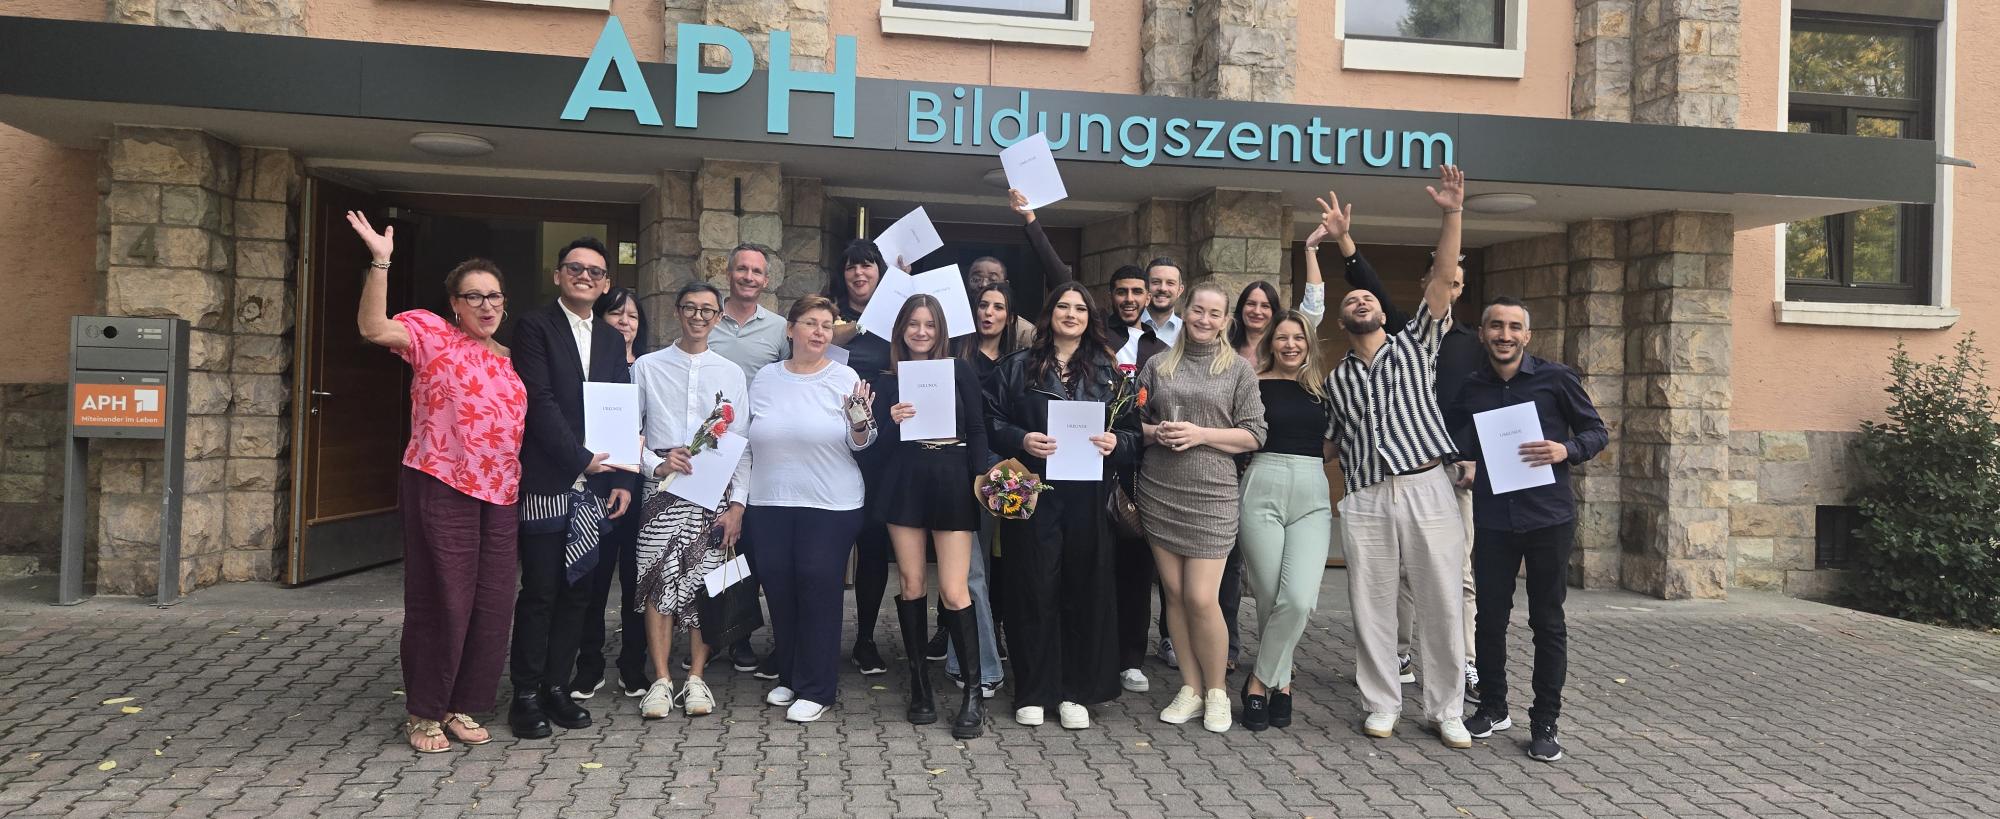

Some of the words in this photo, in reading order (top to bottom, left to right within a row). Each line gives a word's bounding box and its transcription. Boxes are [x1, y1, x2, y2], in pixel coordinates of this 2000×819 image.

[560, 15, 857, 138] APH
[908, 86, 1453, 168] Bildungszentrum
[127, 223, 159, 266] 4
[81, 394, 126, 411] APH
[81, 415, 123, 423] Miteinander
